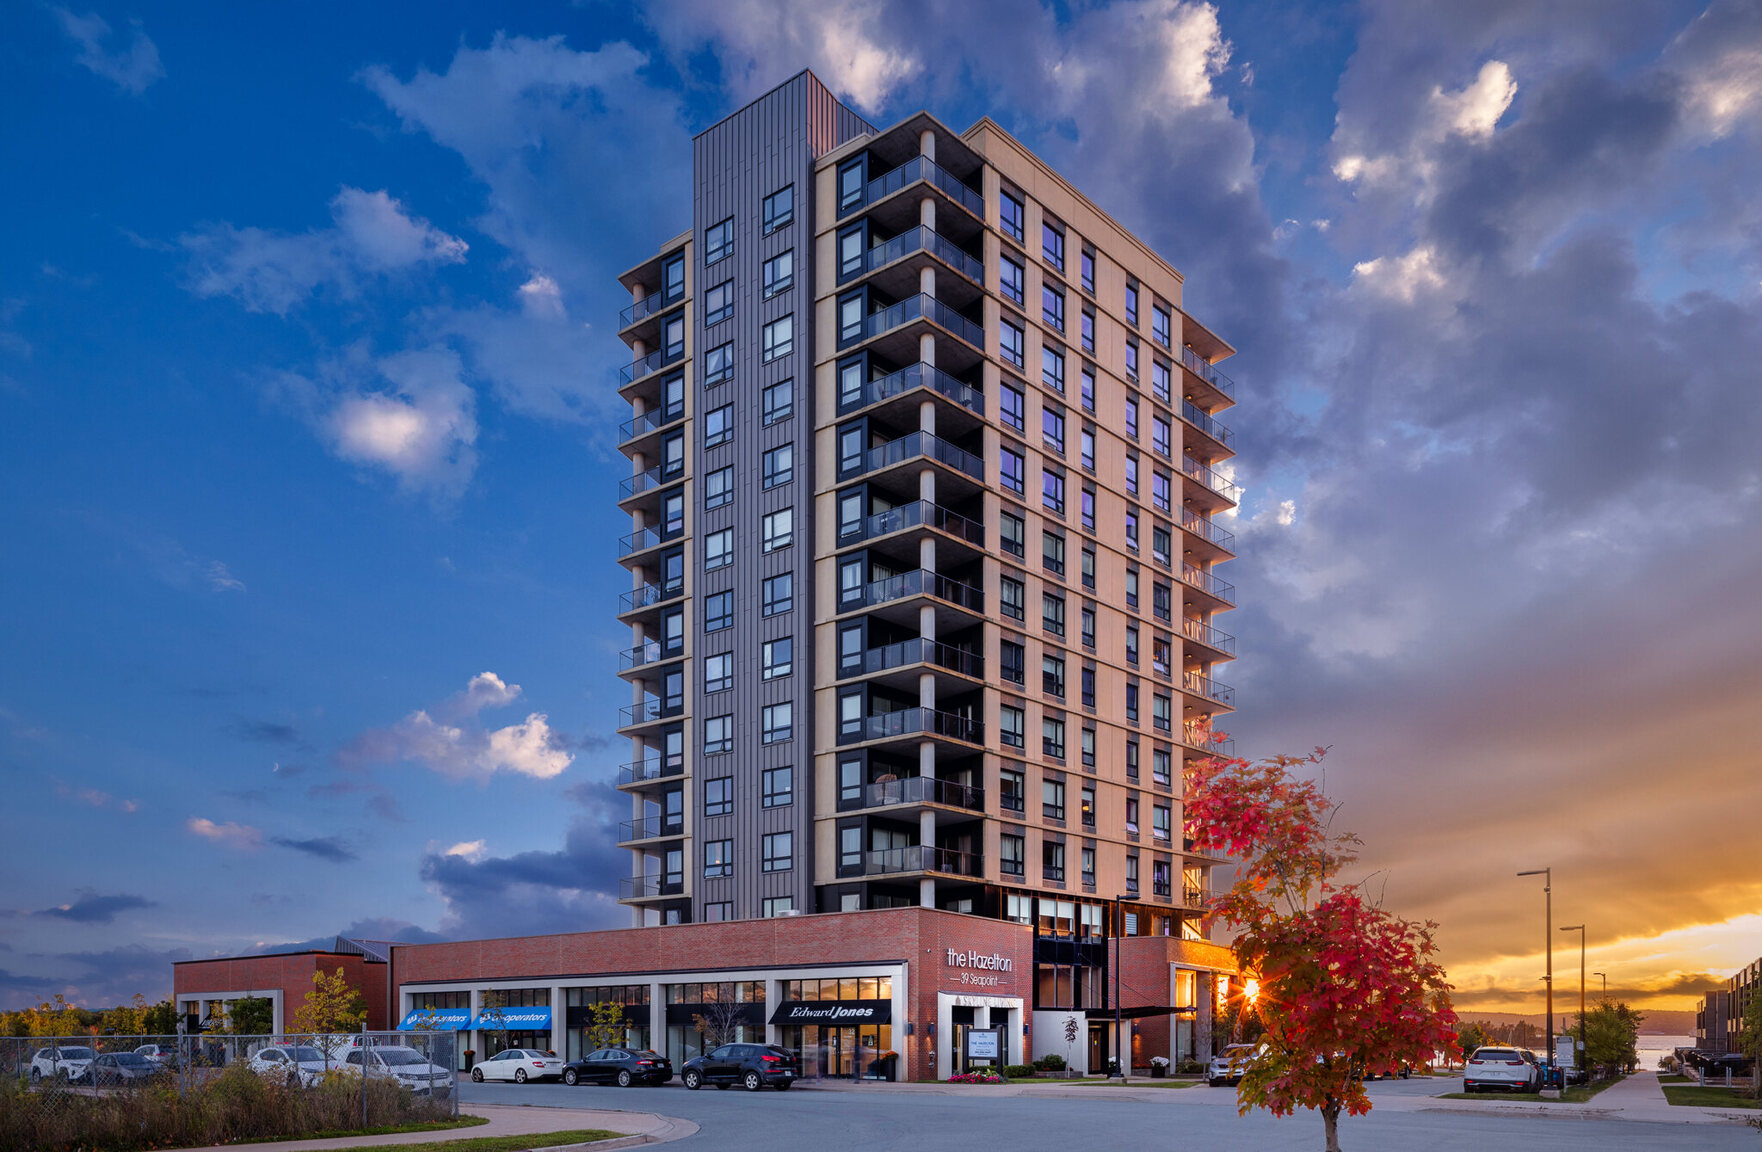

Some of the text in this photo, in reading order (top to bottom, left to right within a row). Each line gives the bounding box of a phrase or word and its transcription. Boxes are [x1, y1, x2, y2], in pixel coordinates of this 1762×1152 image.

[947, 948, 1012, 971] the Hazelton
[960, 972, 998, 987] 39 Seapoint
[789, 1006, 874, 1019] Edward Jones
